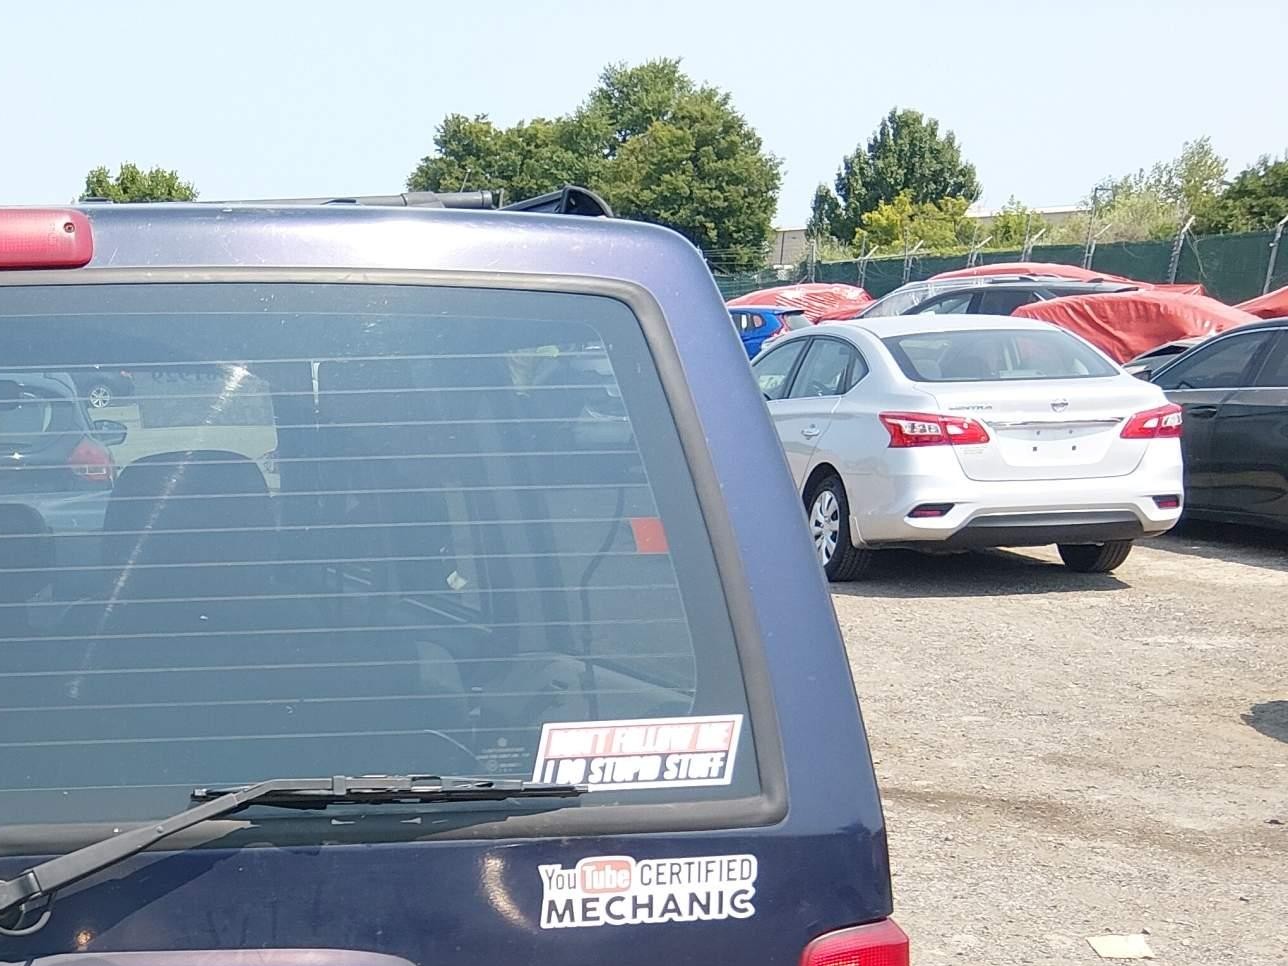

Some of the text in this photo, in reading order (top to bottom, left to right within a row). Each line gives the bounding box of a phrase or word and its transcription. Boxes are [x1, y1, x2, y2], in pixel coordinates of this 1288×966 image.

[544, 760, 555, 784] I
[664, 752, 727, 779] STUFF
[640, 858, 753, 886] CERTIFIED
[546, 889, 755, 924] MECHANIC
